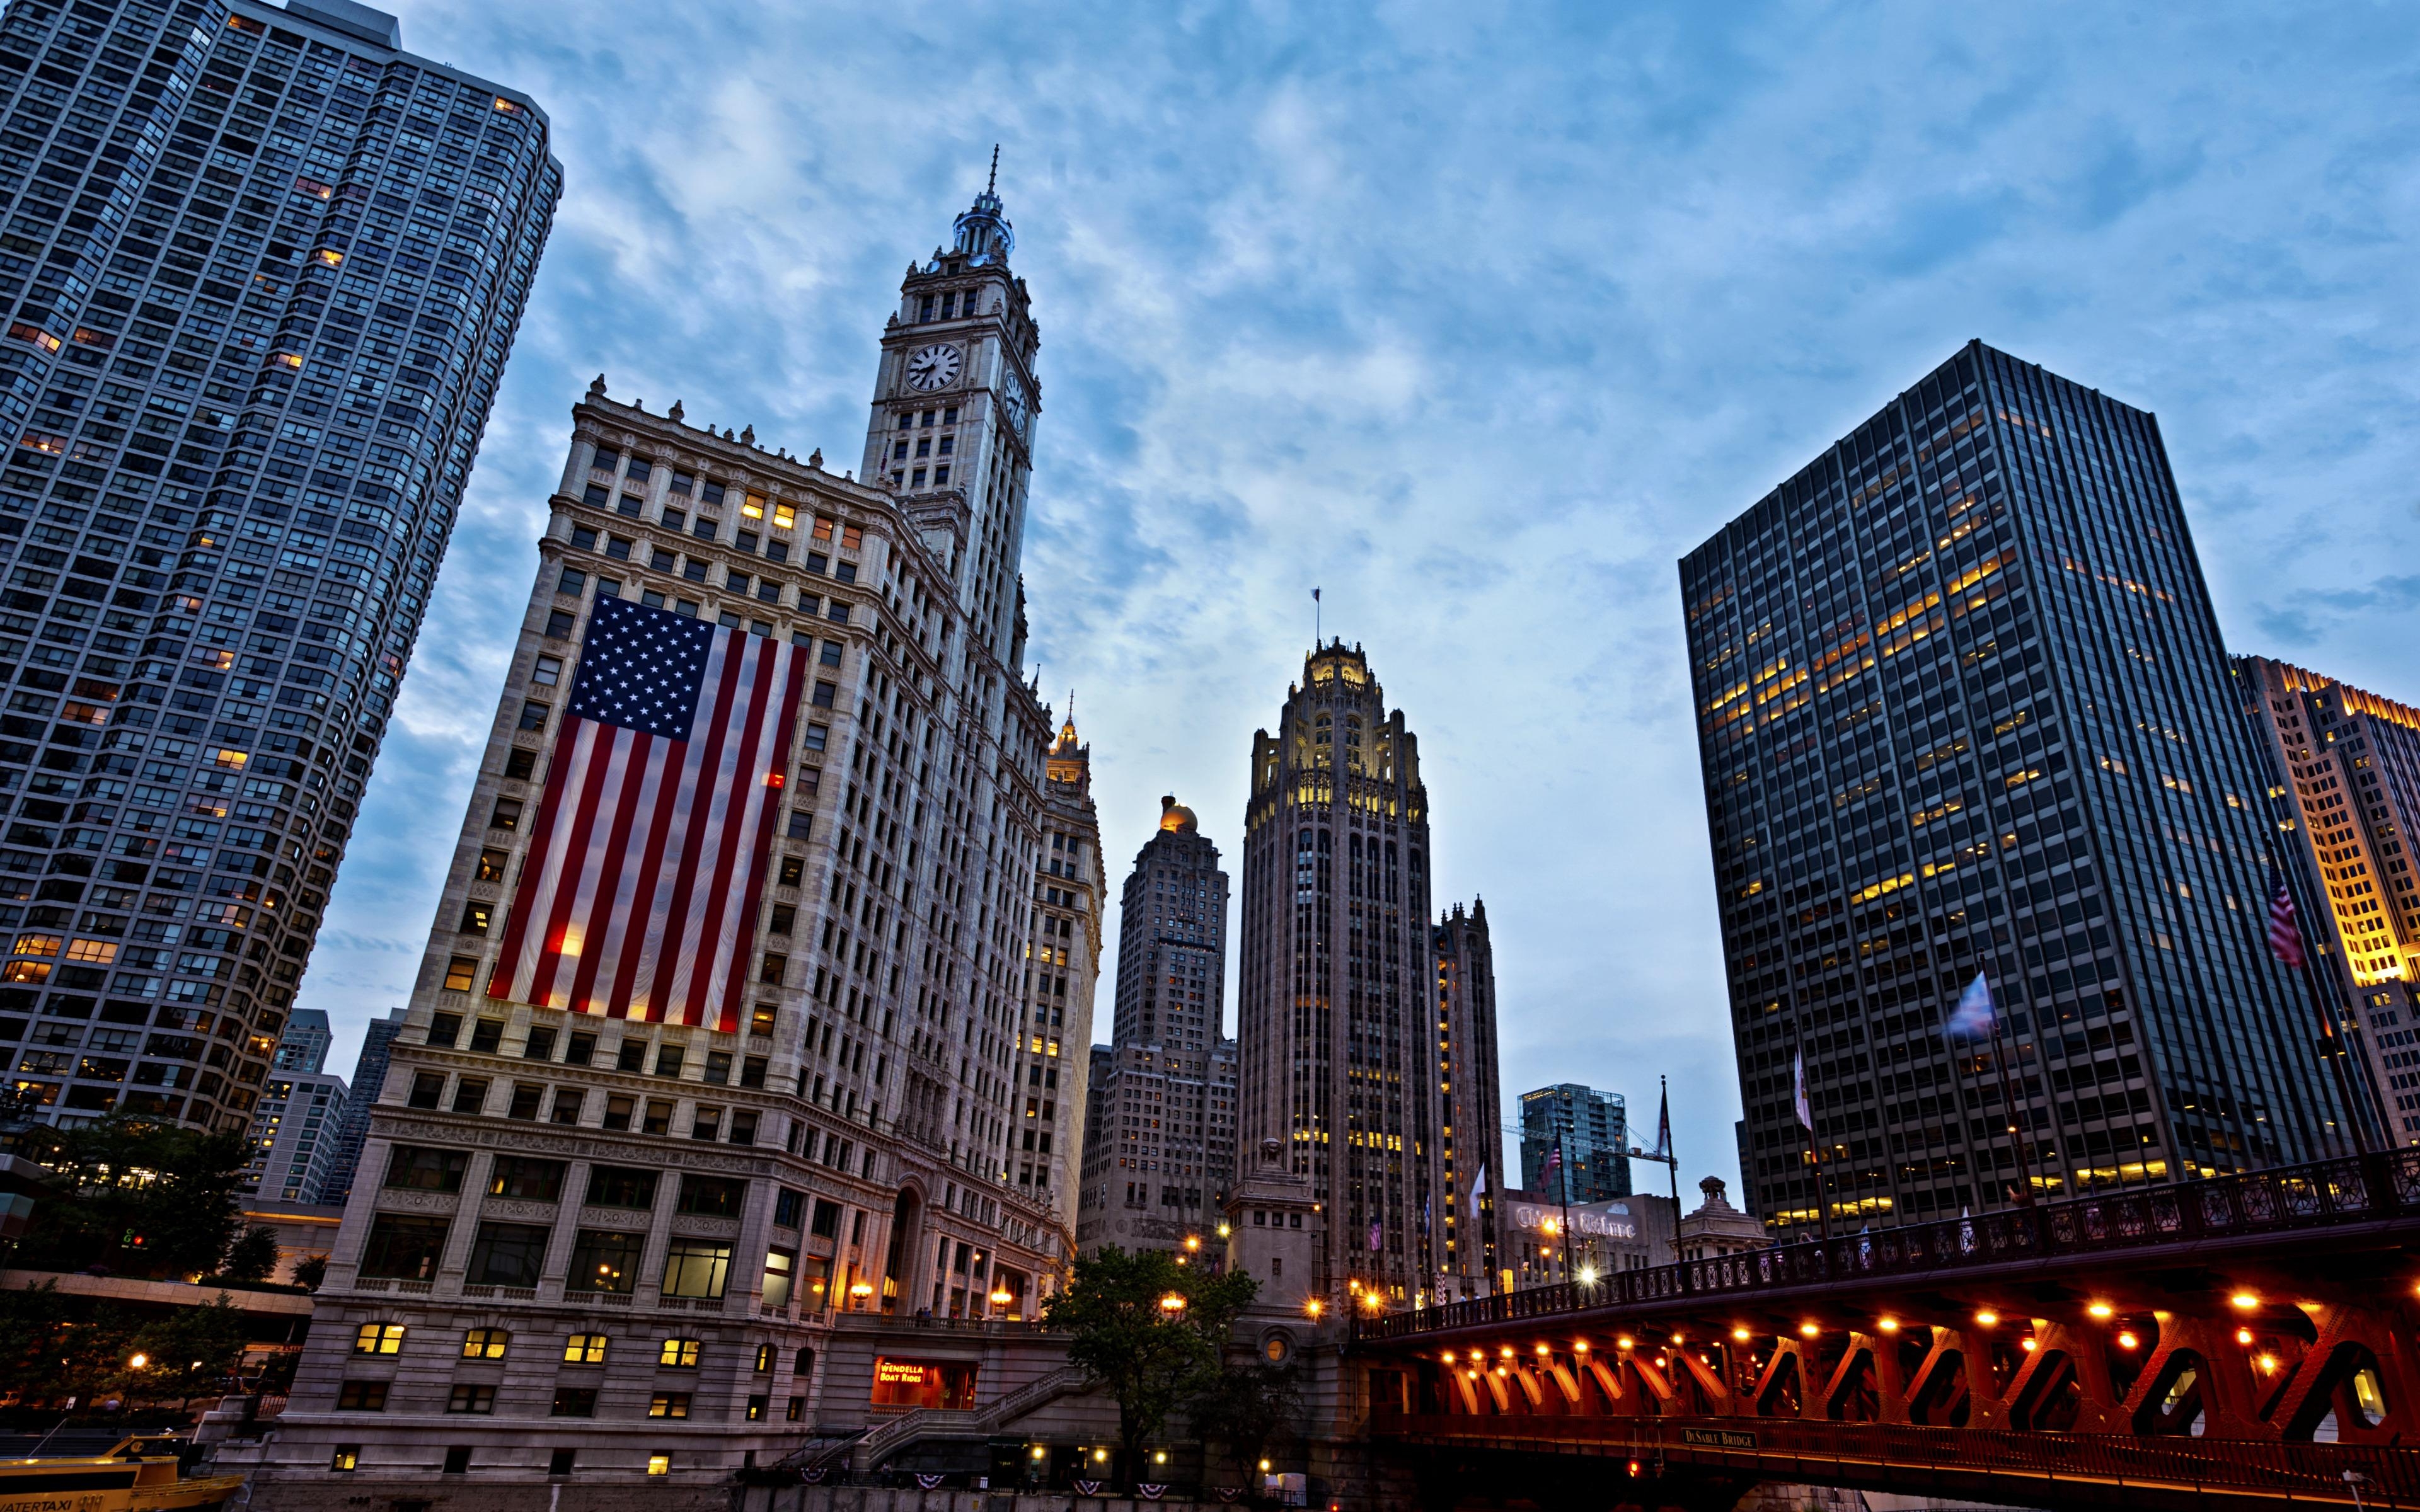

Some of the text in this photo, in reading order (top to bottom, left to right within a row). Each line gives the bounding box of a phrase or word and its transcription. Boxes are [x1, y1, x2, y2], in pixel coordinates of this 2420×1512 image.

[1516, 1206, 1637, 1239] Chicgo Tribune
[881, 1365, 923, 1373] WENDELLA
[880, 1372, 921, 1383] BOAT RIDES
[1721, 1431, 1753, 1447] BRIDGE
